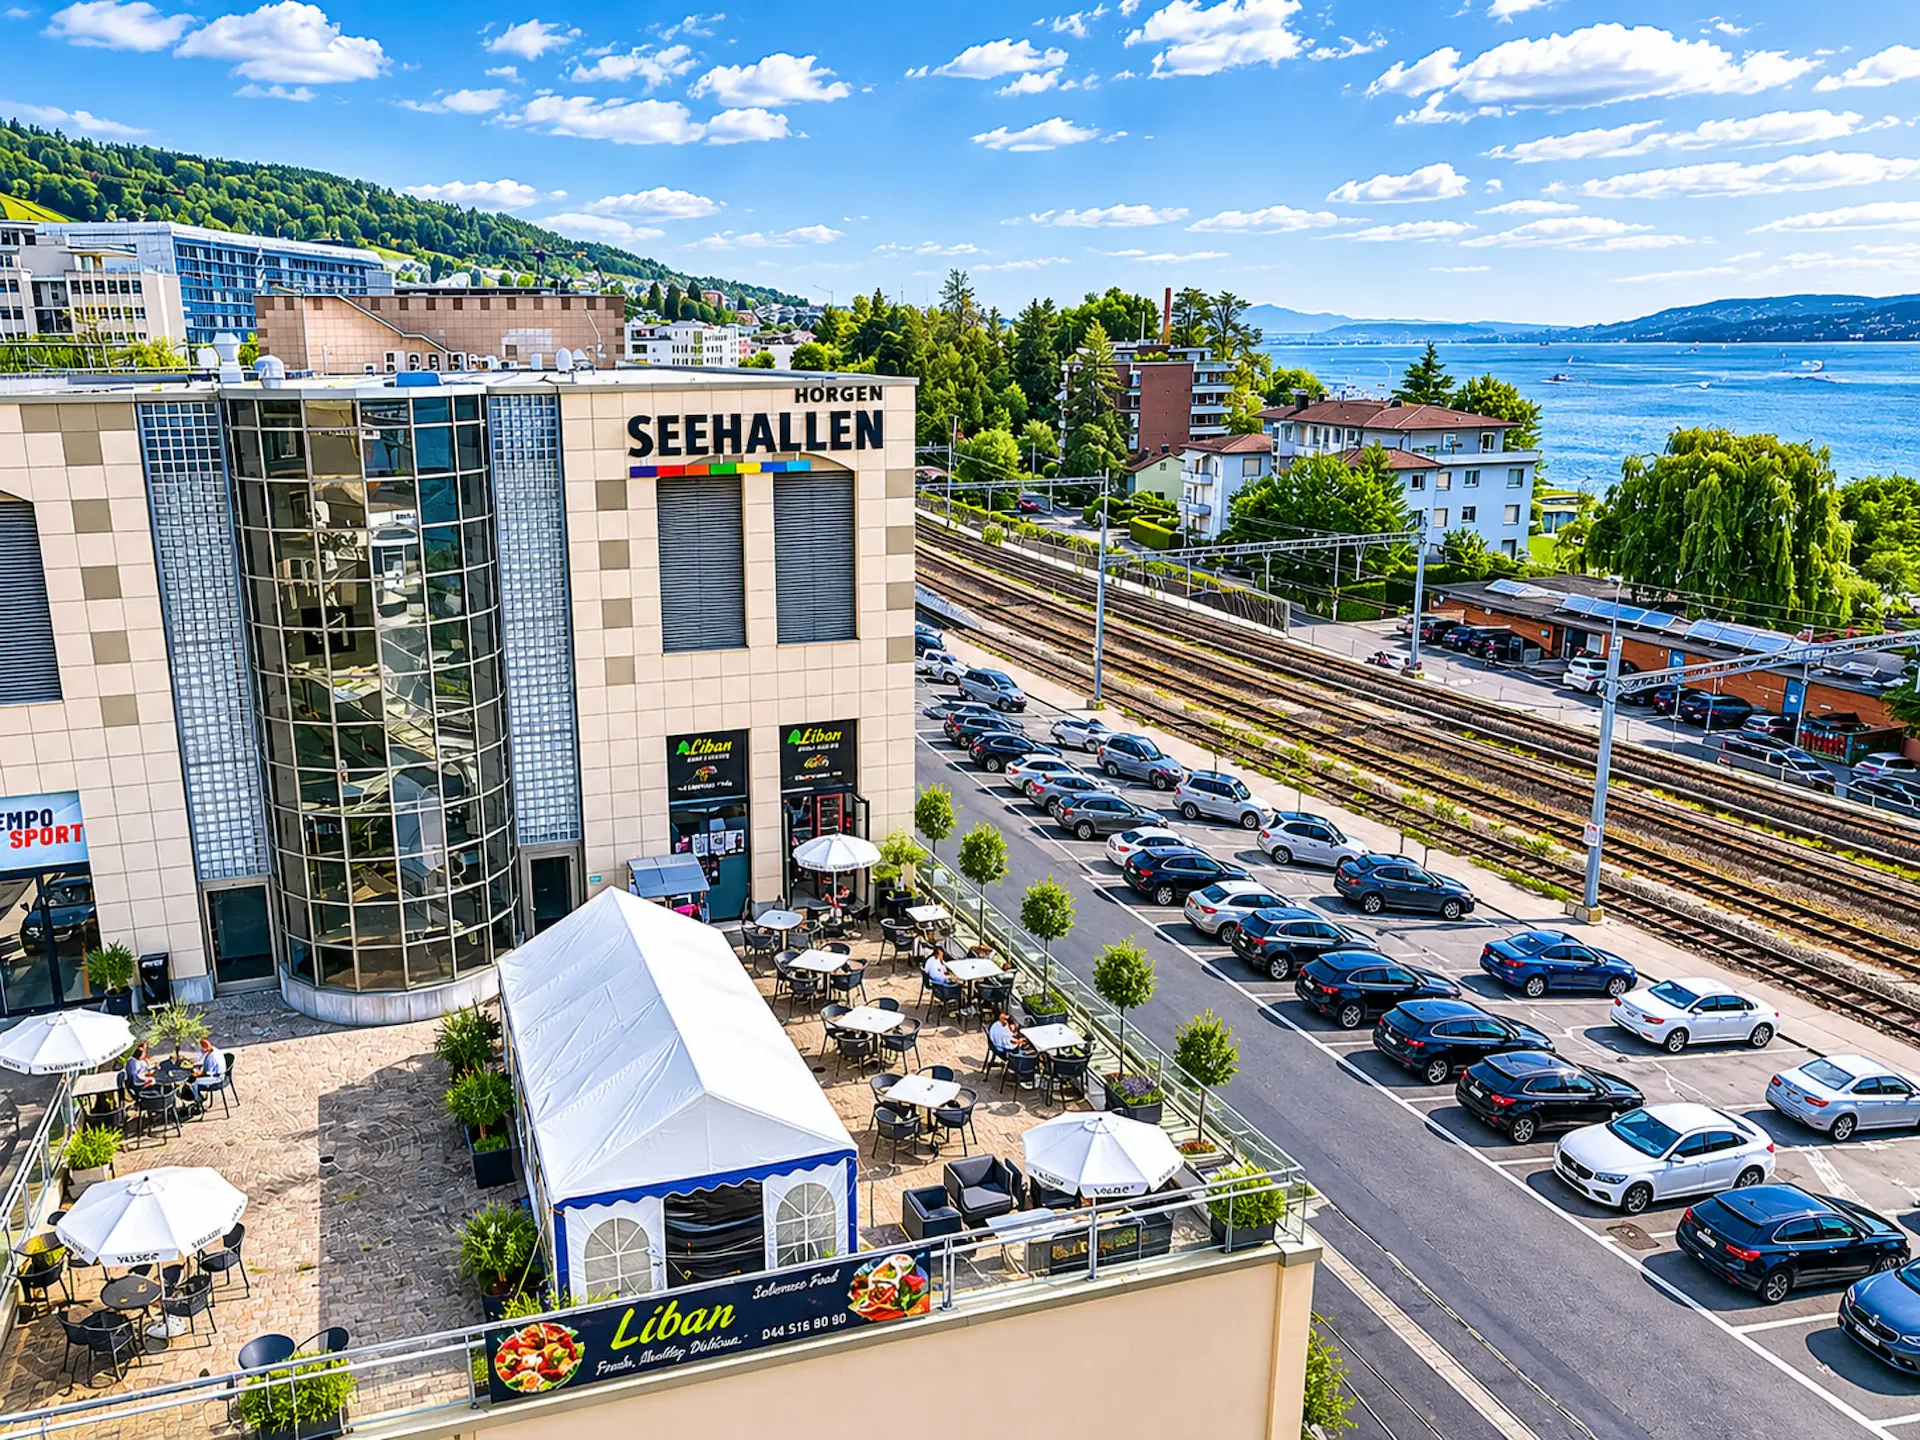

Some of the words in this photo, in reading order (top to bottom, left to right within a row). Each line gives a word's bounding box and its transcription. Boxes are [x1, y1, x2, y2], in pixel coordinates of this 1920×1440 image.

[795, 386, 883, 403] HORGEN
[627, 410, 884, 458] SEEHALLEN
[10, 824, 83, 849] SPORT
[610, 1299, 737, 1350] Liban
[813, 1316, 829, 1329] 80
[831, 1312, 847, 1325] 90
